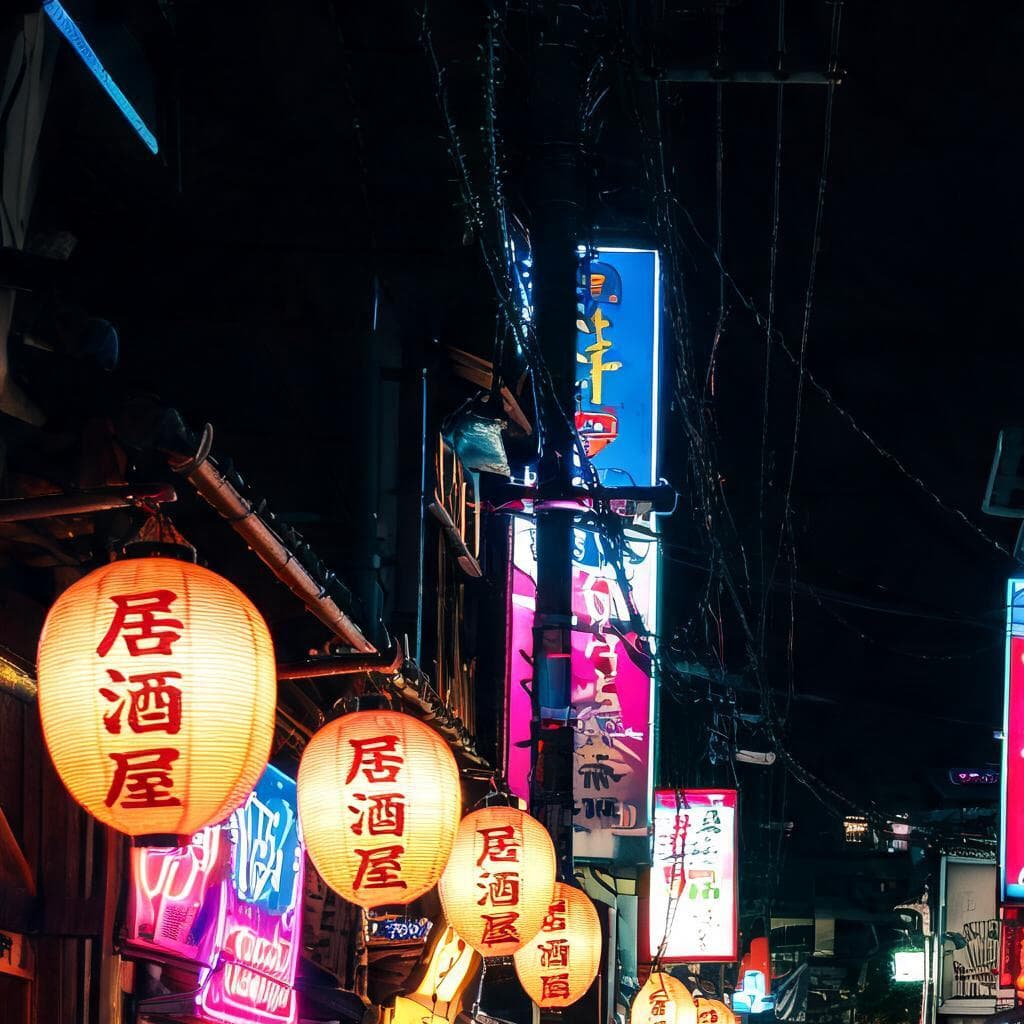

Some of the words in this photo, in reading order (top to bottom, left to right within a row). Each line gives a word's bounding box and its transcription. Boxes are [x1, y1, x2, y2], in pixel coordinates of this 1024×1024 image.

[97, 589, 184, 811] 居酒屋
[345, 735, 408, 891] 居酒屋
[476, 825, 521, 949] 居酒屋
